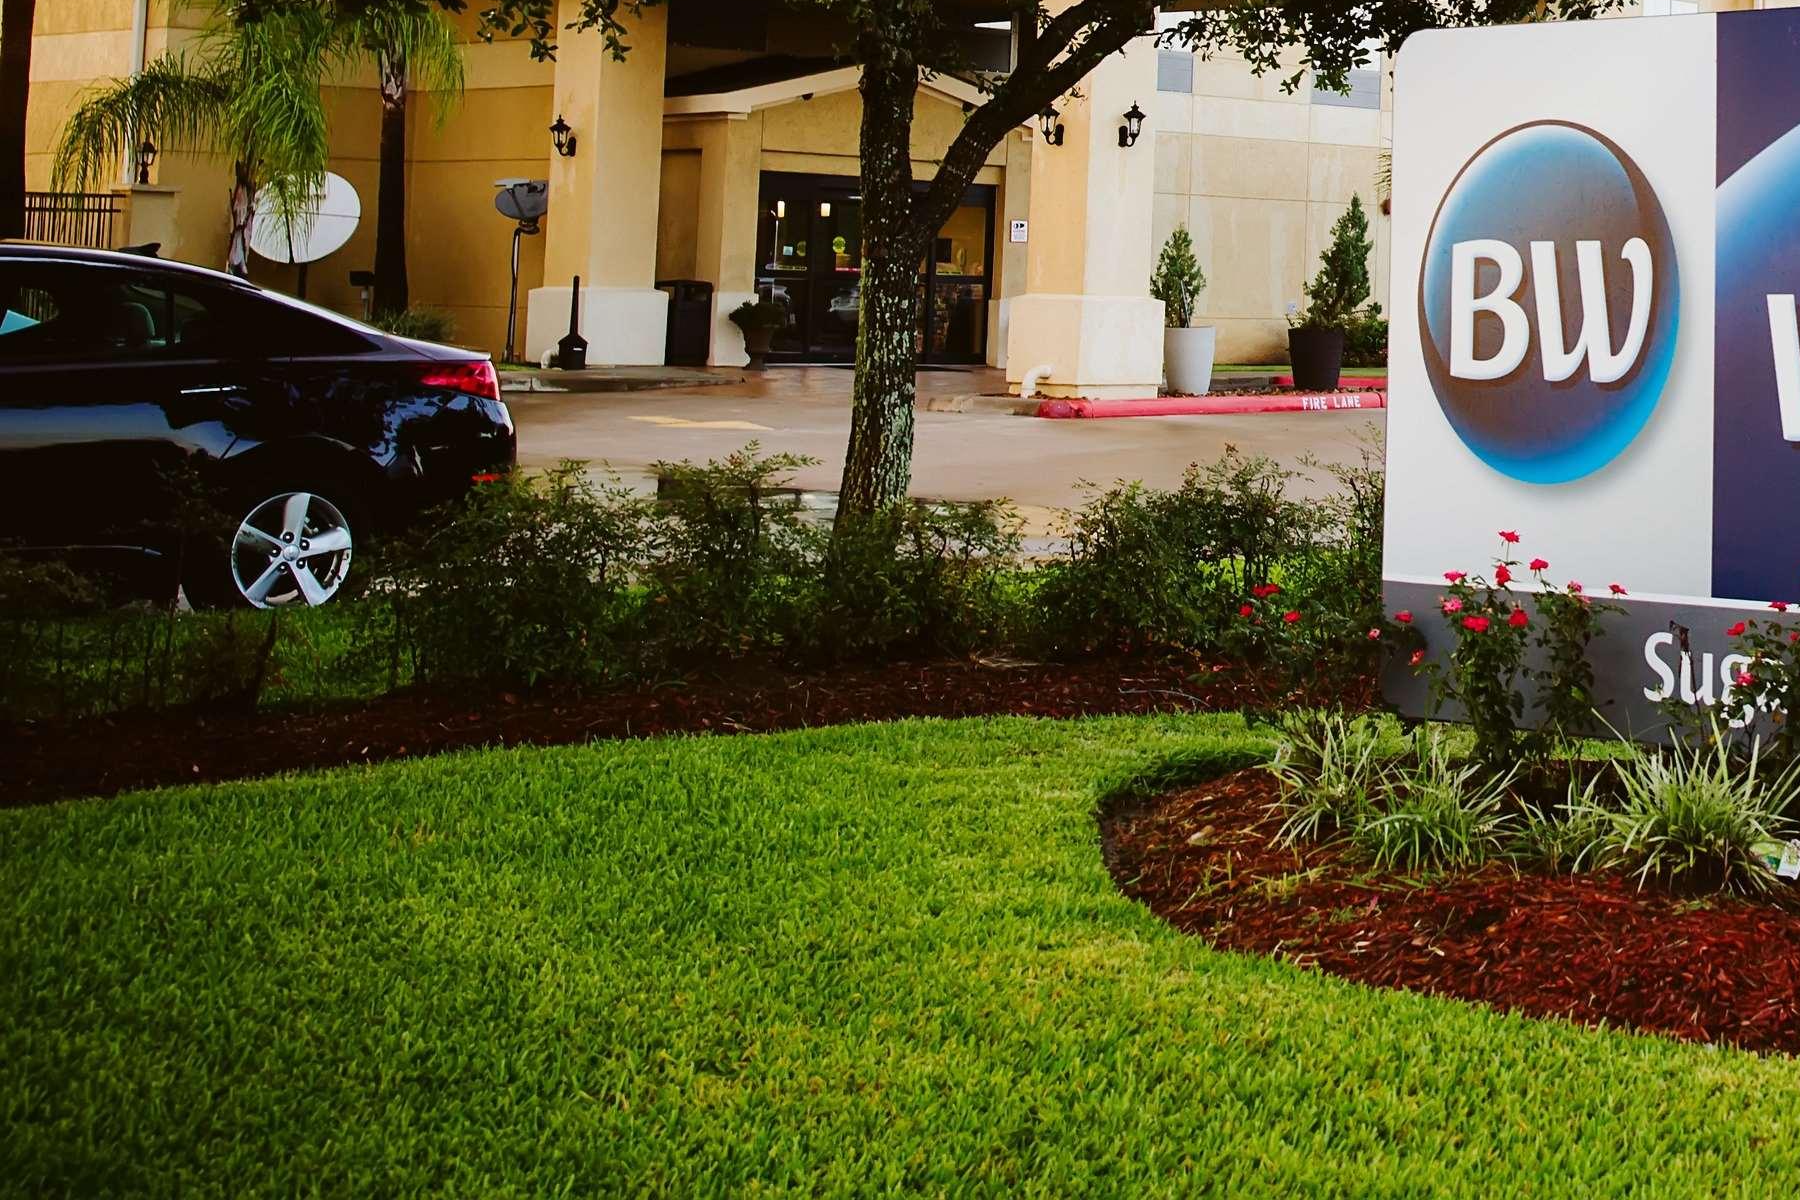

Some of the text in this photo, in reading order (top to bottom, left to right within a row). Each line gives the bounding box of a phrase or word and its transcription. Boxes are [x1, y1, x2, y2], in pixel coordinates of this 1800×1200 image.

[1449, 236, 1654, 383] BW
[1302, 395, 1361, 410] FIRE LANE
